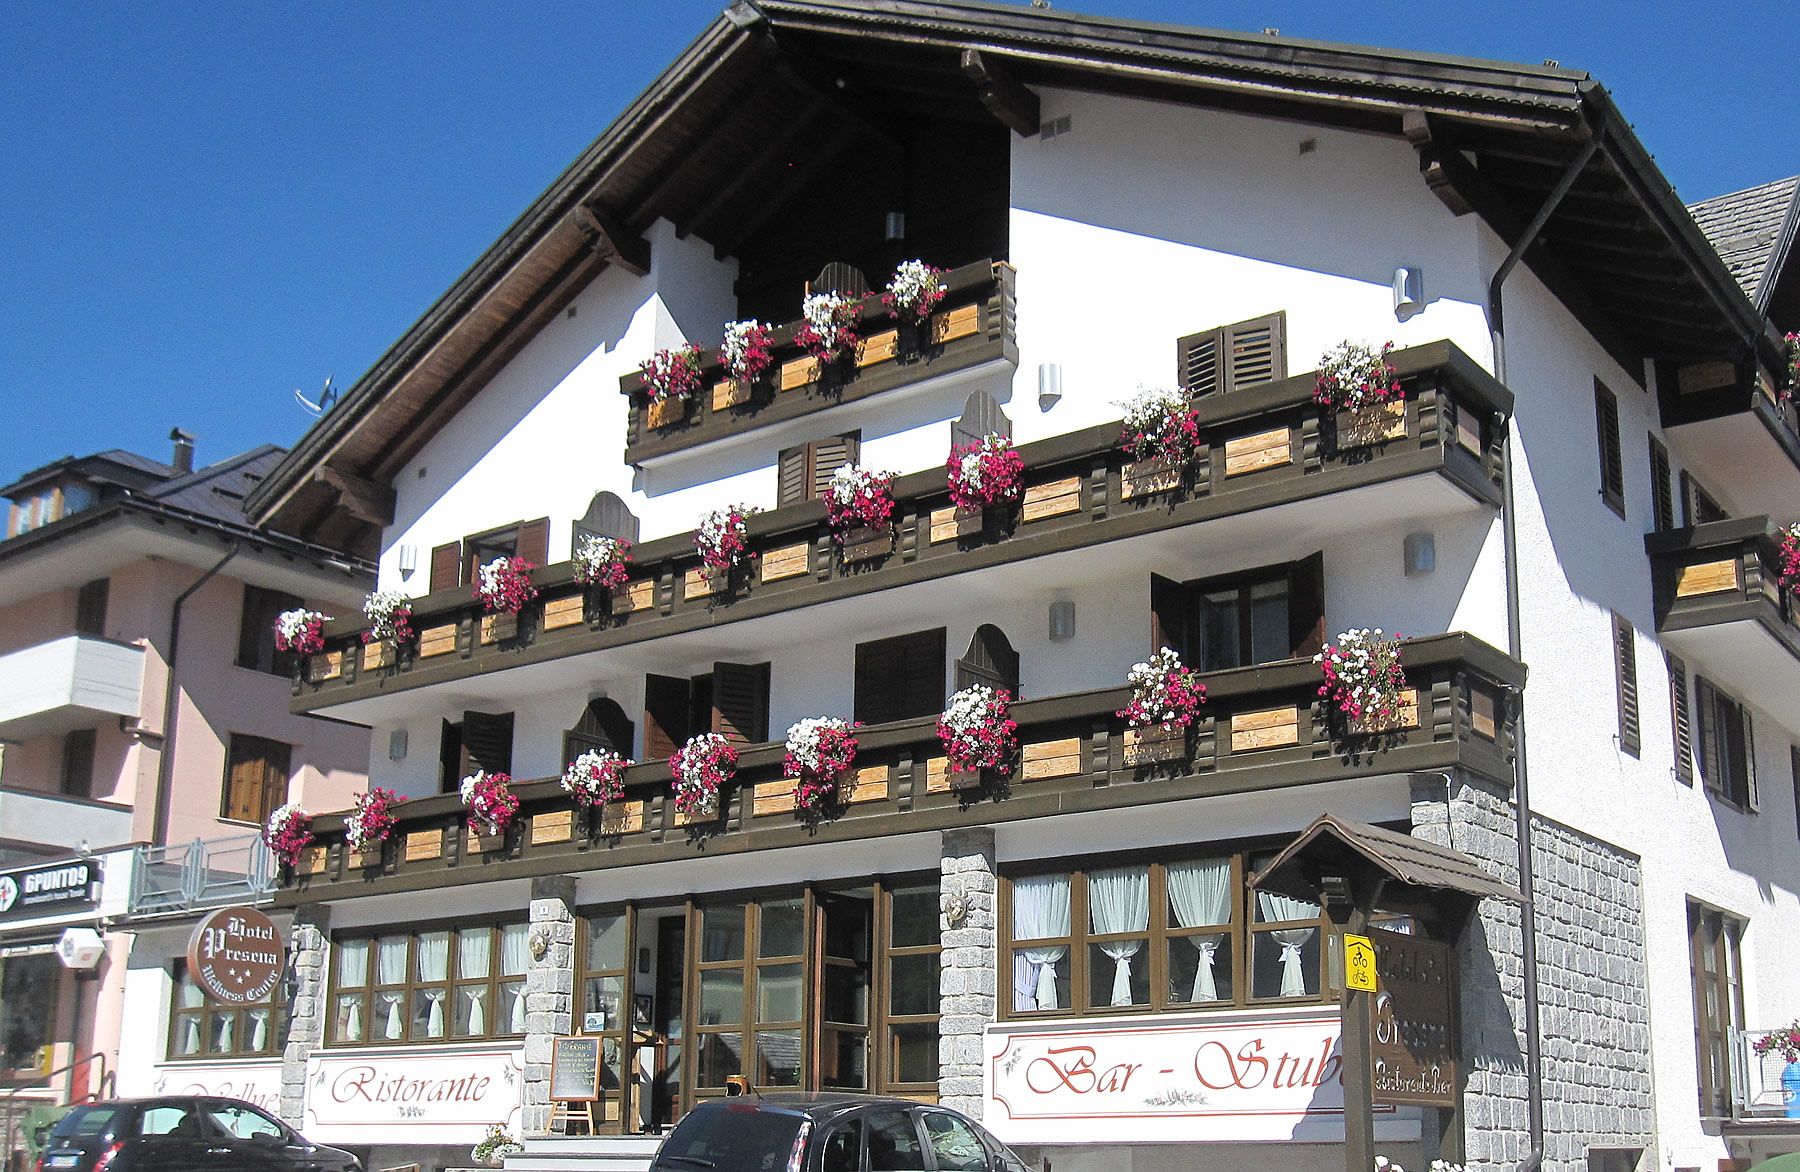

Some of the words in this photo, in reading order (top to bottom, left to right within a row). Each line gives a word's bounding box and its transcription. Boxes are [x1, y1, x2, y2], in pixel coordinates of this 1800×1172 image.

[25, 865, 88, 893] 6PUNTO9
[204, 927, 277, 965] Presena
[228, 917, 274, 941] Hotel
[202, 964, 245, 1001] Wellness
[246, 969, 279, 1001] Center
[331, 1065, 491, 1104] Ristorante
[1026, 1046, 1142, 1094] Bar
[1194, 1038, 1343, 1090] Stub
